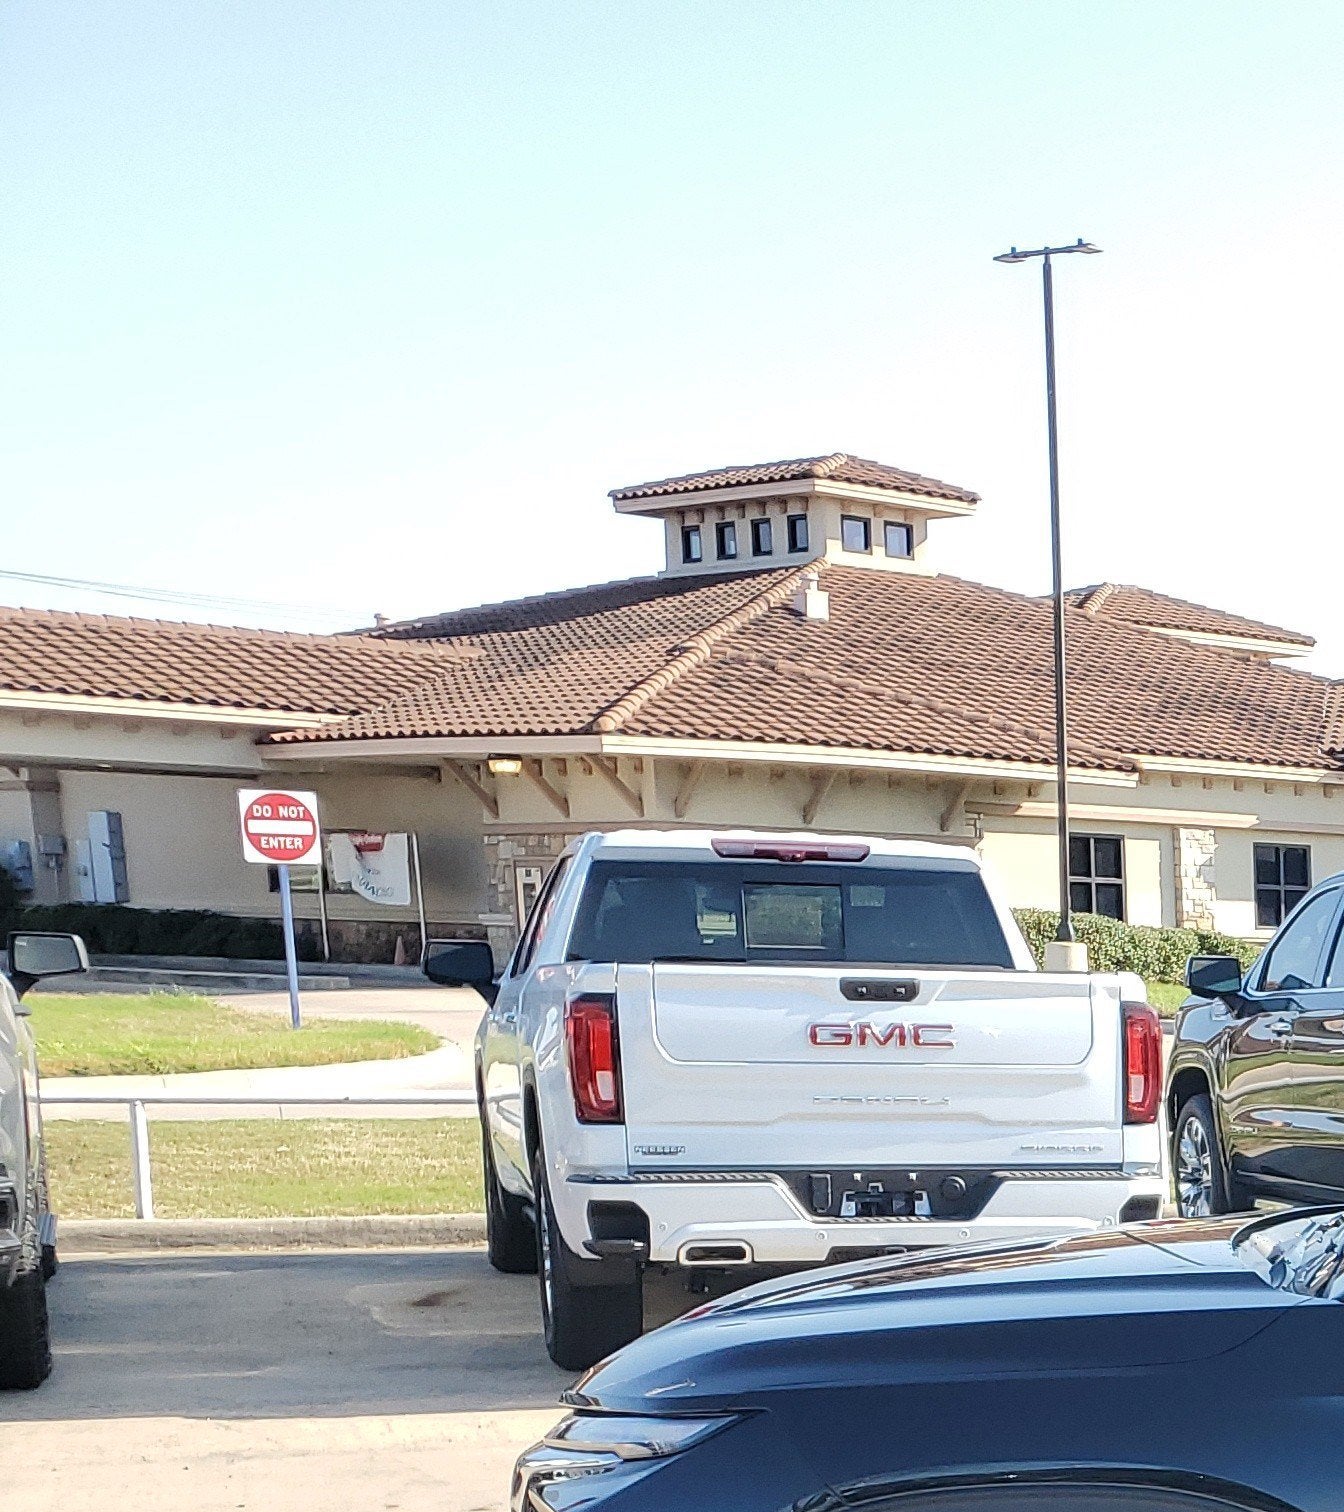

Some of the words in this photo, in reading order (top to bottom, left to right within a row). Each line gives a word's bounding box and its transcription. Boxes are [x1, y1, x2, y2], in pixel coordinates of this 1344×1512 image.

[252, 804, 271, 817] DO
[278, 805, 305, 819] NOT
[260, 837, 303, 850] ENTER
[808, 1023, 955, 1049] GMC
